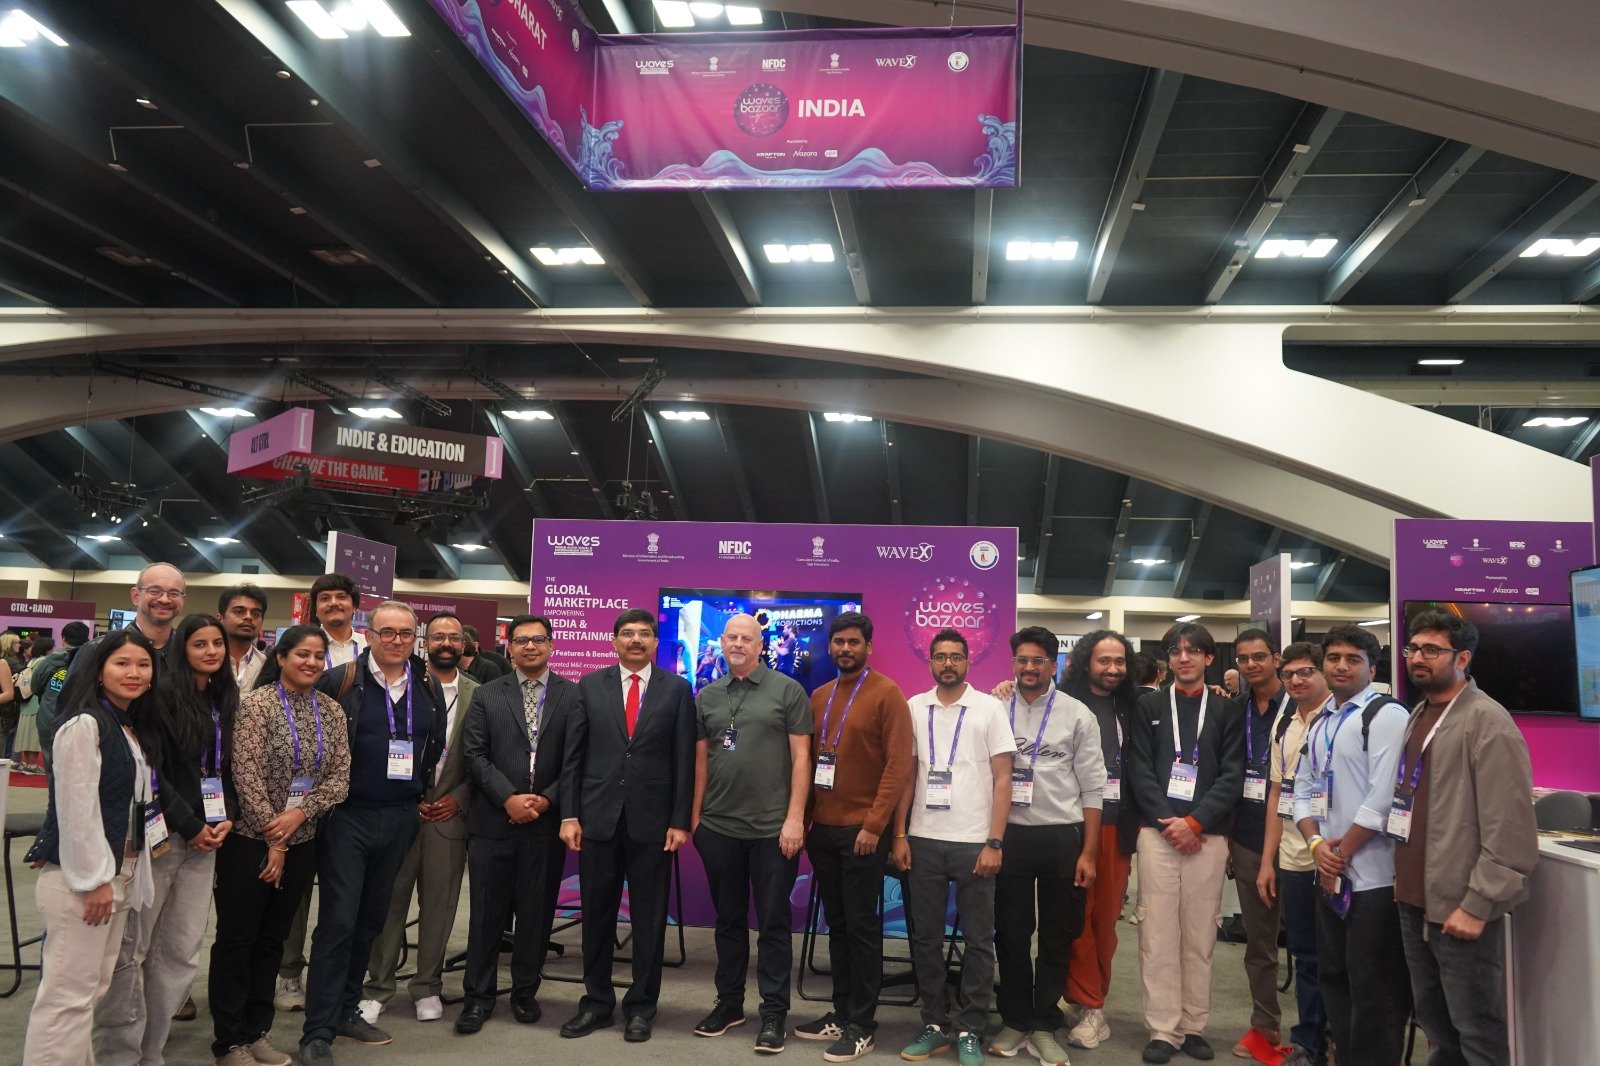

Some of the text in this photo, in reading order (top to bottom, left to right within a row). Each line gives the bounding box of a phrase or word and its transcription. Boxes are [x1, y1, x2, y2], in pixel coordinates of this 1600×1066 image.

[508, 0, 547, 50] HARAT
[762, 59, 786, 69] NFDC
[876, 55, 917, 68] WAVEX
[743, 97, 781, 105] waves
[740, 103, 782, 113] bazaar
[798, 99, 866, 117] INDIA
[792, 148, 818, 157] Nazara
[336, 426, 465, 462] INDIE & EDUCATION
[272, 454, 388, 482] CHANGE THE GAME.
[548, 536, 600, 546] waves
[718, 540, 752, 554] NFDC
[876, 543, 936, 562] WAVEX
[1482, 556, 1508, 565] WAVEX
[544, 584, 591, 596] GLOBAL
[1493, 584, 1518, 594] Nazara
[10, 602, 54, 614] CTRL+BAND
[544, 597, 629, 609] MARKETPLACE
[920, 602, 984, 614] waves
[774, 608, 824, 620] DHARMA
[916, 610, 984, 628] bazaar
[579, 620, 588, 628] &
[552, 631, 614, 642] NTERTAINME
